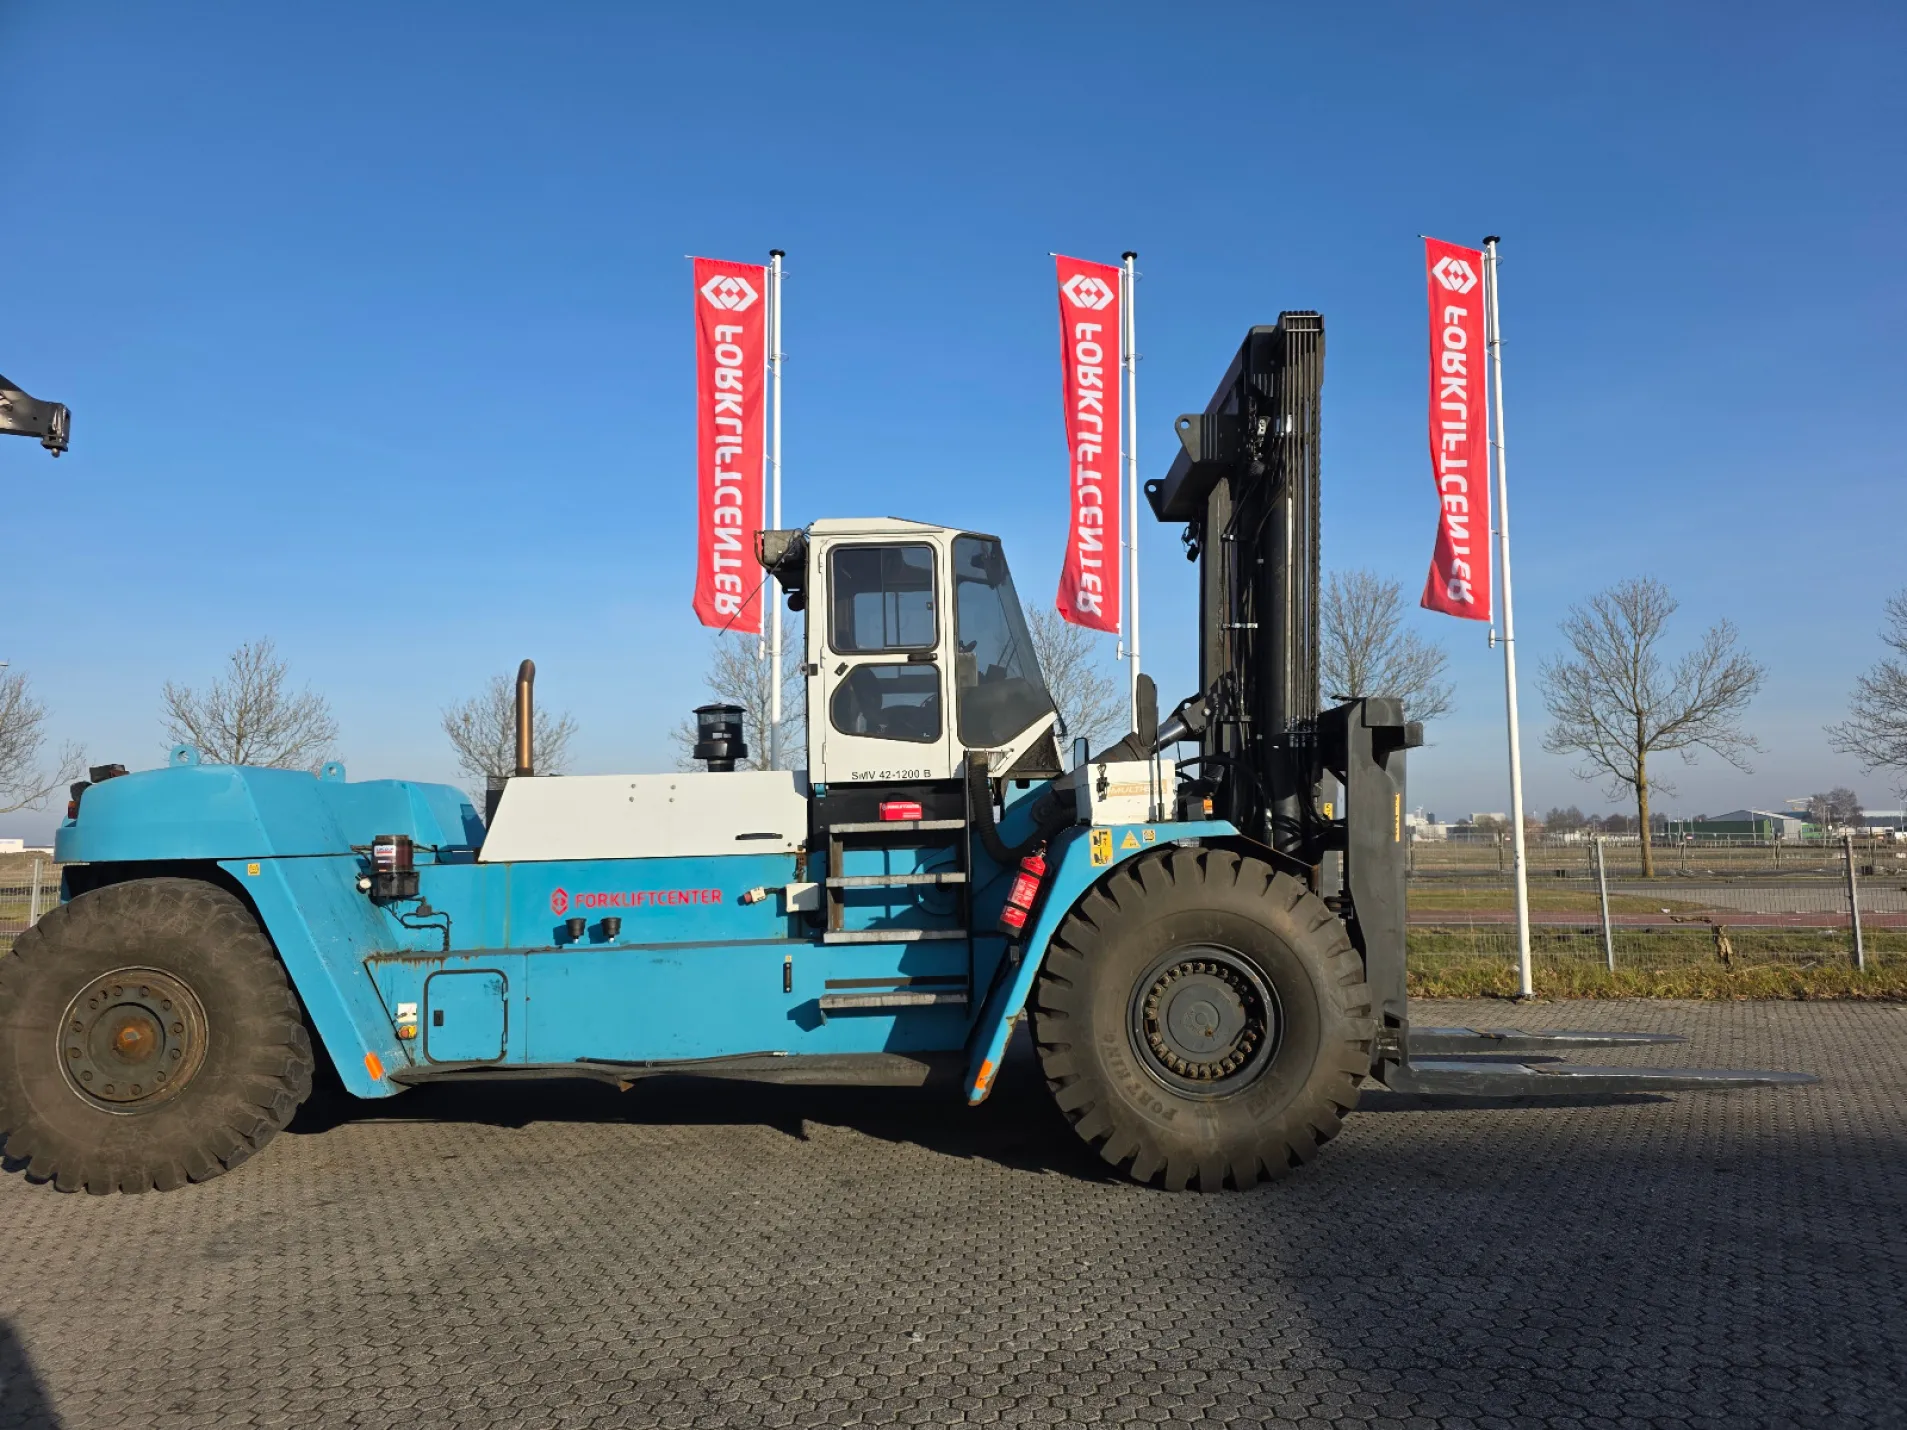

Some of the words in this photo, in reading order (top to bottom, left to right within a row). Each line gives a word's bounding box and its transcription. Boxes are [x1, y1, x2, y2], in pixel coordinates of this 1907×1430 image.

[851, 771, 876, 780] SMV
[879, 769, 920, 779] 42-1200
[923, 769, 932, 778] B
[575, 888, 723, 909] FORKLIFTCENTER
